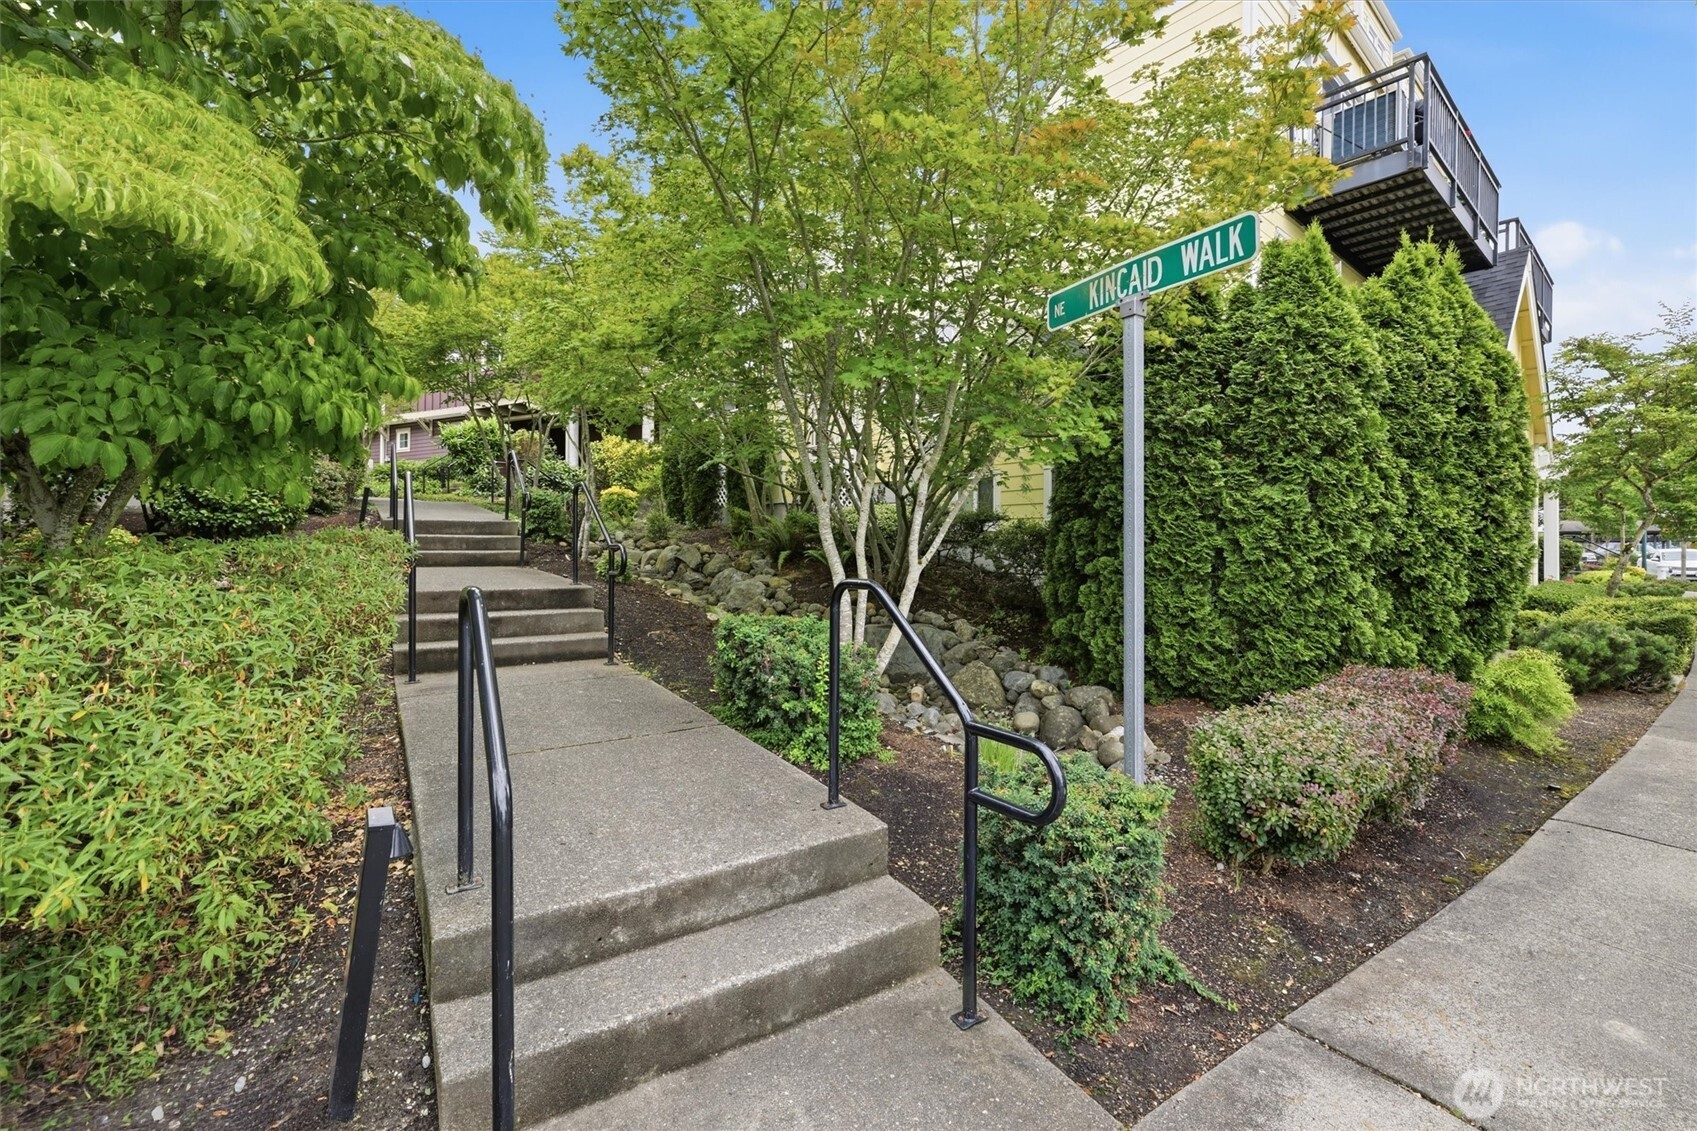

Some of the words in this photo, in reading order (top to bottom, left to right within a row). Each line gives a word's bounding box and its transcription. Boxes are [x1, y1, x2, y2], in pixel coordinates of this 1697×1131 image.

[1054, 301, 1065, 319] NE
[1089, 256, 1163, 310] KINCAID
[1181, 222, 1245, 276] WALK
